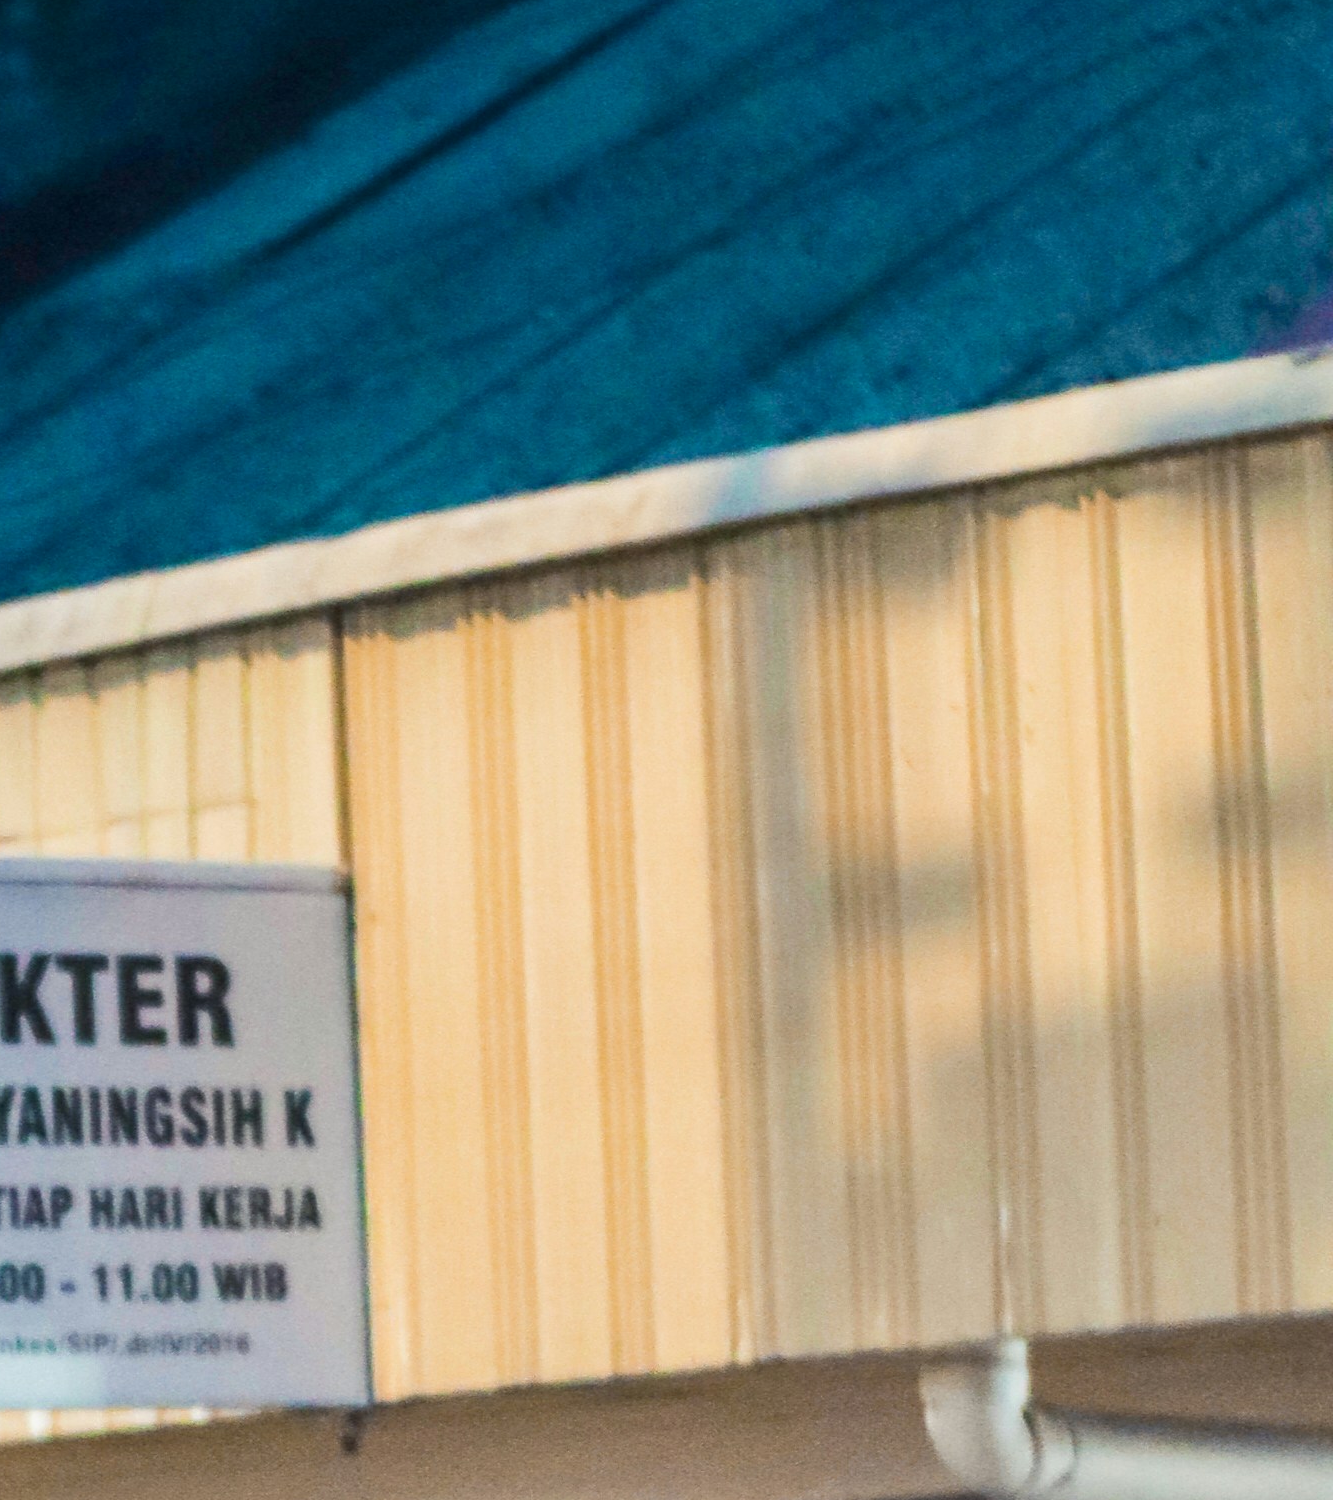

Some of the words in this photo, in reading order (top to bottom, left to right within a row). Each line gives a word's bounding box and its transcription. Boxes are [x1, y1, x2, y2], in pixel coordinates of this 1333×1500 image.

[284, 1087, 316, 1148] K
[88, 1187, 184, 1231] HARI
[198, 1185, 322, 1232] KERJA
[91, 1264, 200, 1302] 11.00
[213, 1263, 288, 1302] WIB
